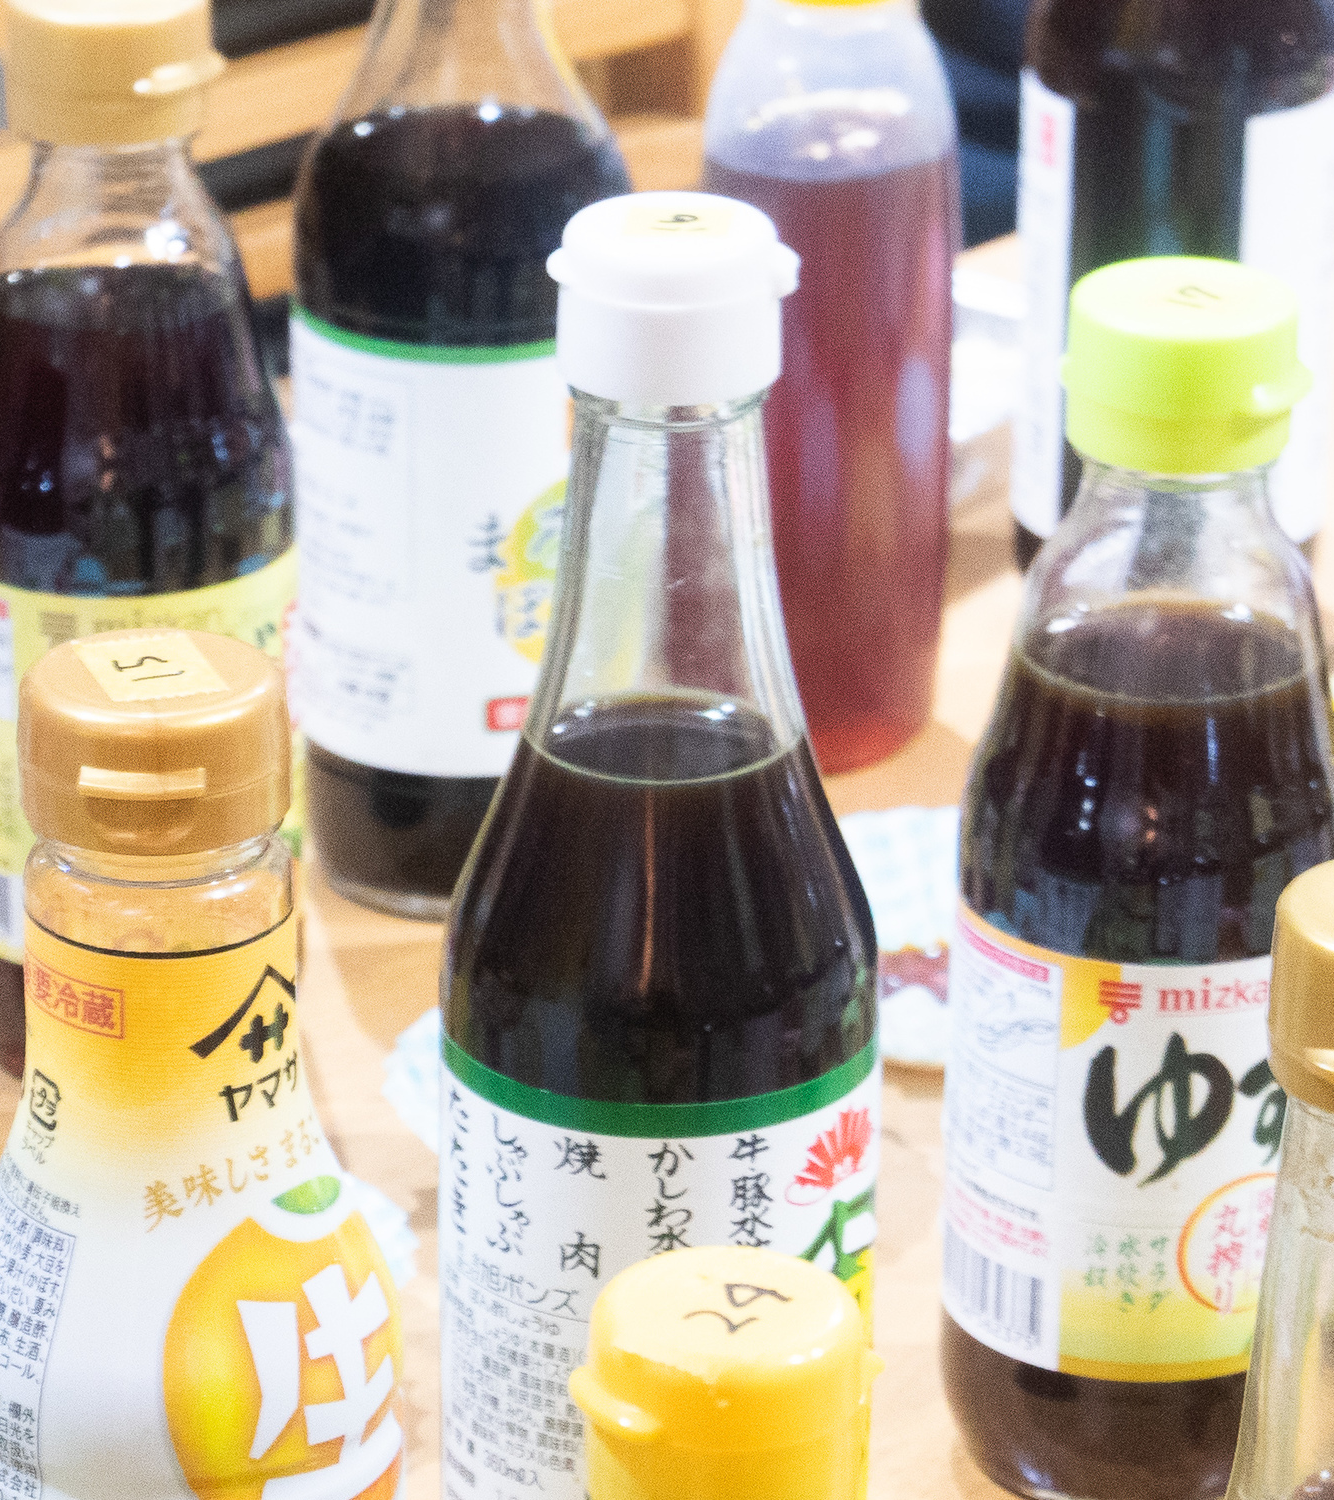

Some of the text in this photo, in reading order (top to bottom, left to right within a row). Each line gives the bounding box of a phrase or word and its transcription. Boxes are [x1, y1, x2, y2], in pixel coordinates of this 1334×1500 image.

[145, 1145, 270, 1233] 美味しさ
[485, 1113, 531, 1256] しゃぶしゃぶ
[645, 1142, 695, 1256] かしわ水
